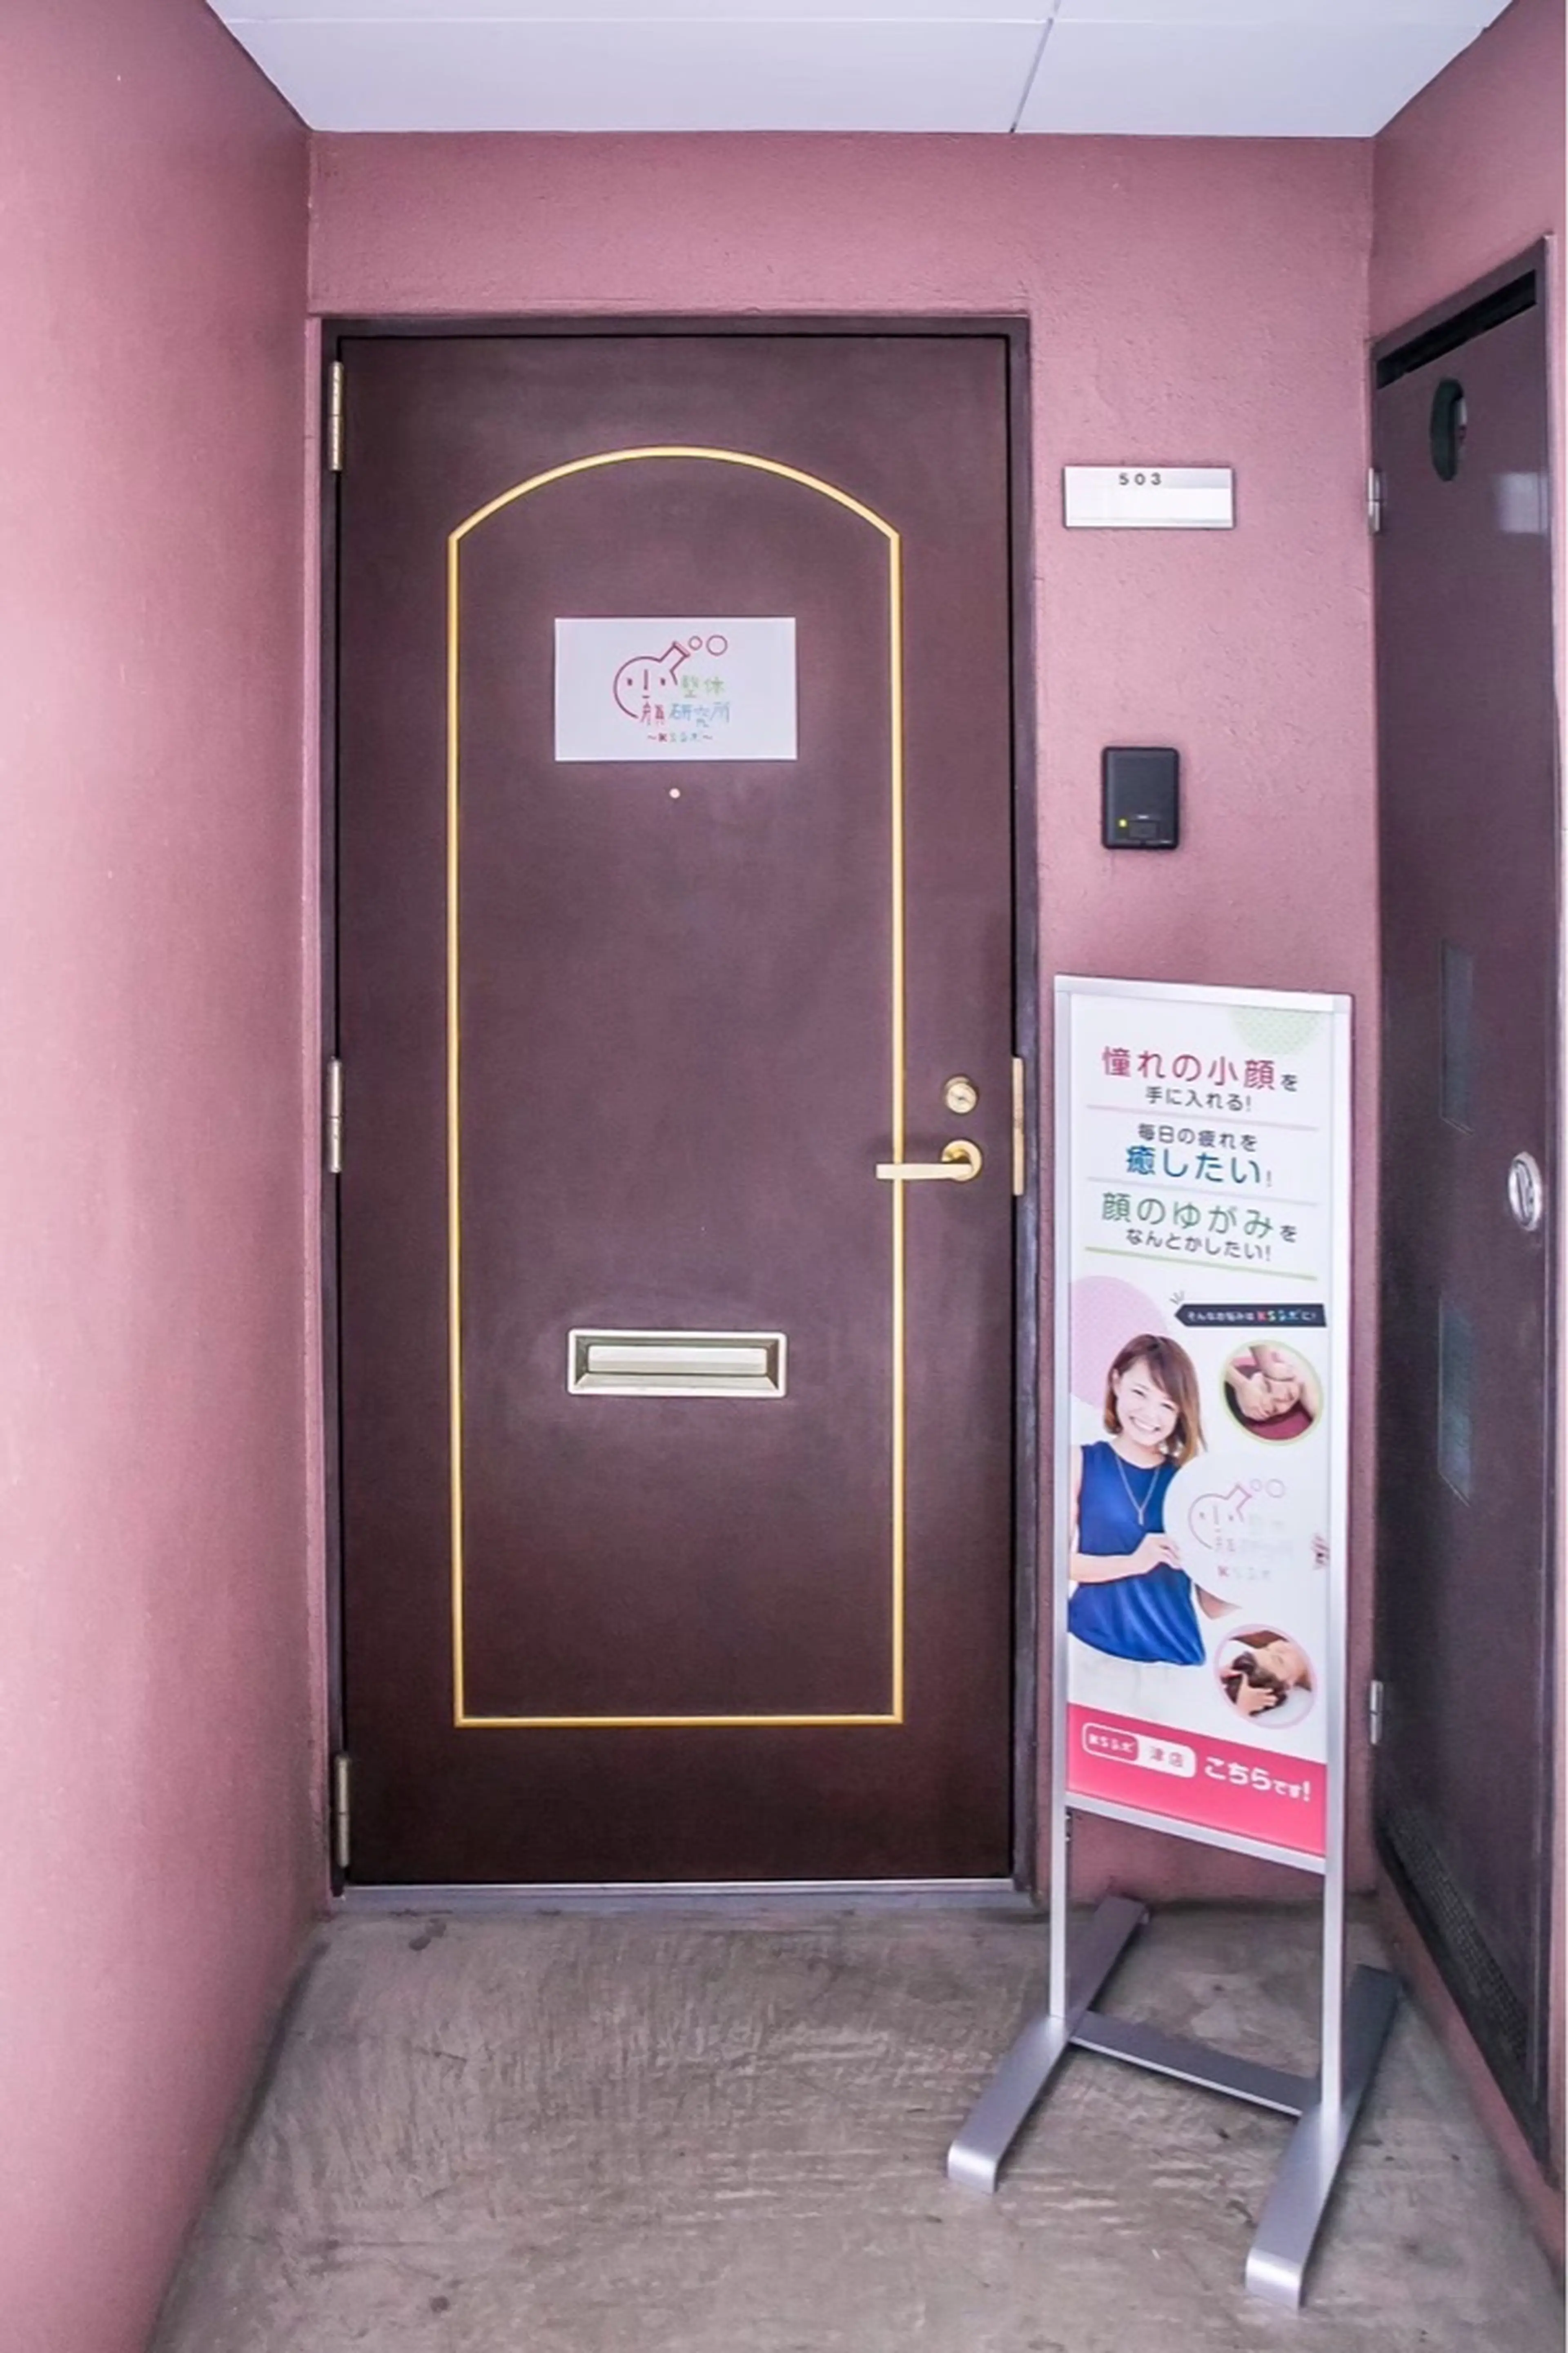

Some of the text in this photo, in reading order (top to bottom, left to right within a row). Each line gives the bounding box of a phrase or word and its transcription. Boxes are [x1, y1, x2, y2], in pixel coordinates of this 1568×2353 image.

[1118, 472, 1162, 486] 503
[1102, 1046, 1298, 1092] 憧れの小顔を
[1138, 1123, 1258, 1152] 毎日の疲れを
[1102, 1192, 1298, 1243] 顔のゆがみを
